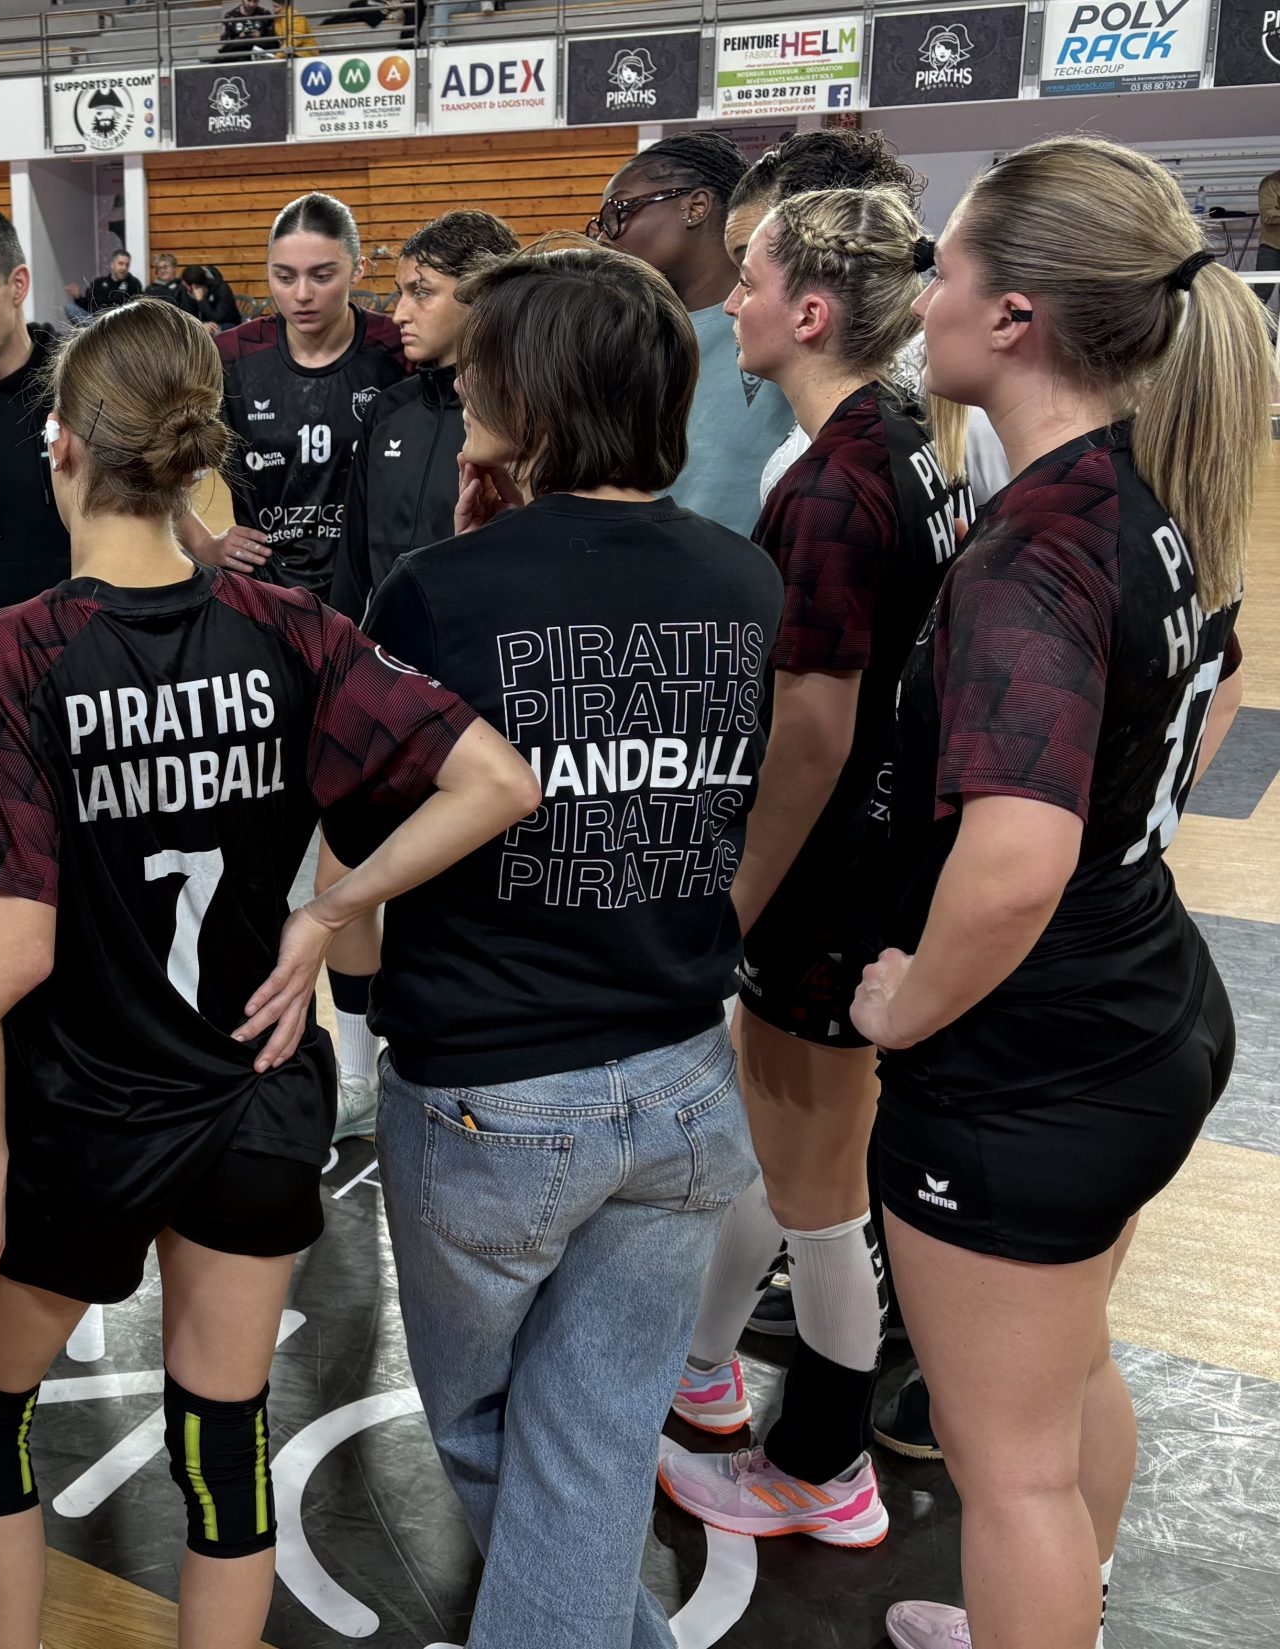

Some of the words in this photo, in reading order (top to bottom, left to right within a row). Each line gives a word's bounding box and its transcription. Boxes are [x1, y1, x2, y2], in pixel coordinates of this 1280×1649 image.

[1068, 0, 1190, 33] POLY
[724, 34, 779, 51] PEINTURE
[780, 27, 856, 58] HELM
[1056, 29, 1179, 65] RACK
[745, 49, 780, 60] FABRICE
[440, 58, 546, 98] ADEX
[915, 67, 973, 88] PIRATHS
[1054, 63, 1125, 77] TECH-GROUP
[54, 80, 107, 92] SUPPORTS
[110, 78, 123, 88] DE
[737, 89, 752, 100] 06
[755, 88, 770, 98] 30
[772, 87, 787, 97] 28
[789, 86, 801, 96] 77
[803, 85, 816, 95] 81
[1130, 83, 1141, 92] 03
[1142, 82, 1153, 91] 88
[1154, 82, 1164, 91] 80
[1165, 81, 1176, 90] 92
[1177, 80, 1188, 89] 27
[305, 97, 371, 111] ALEXANDRE
[374, 94, 406, 107] PETRI
[440, 100, 487, 112] TRANSPORT
[489, 100, 496, 110] &
[497, 97, 546, 109] LOGISTIQUE
[606, 89, 657, 108] PIRATHS
[208, 114, 251, 131] PIRATHS
[320, 123, 332, 133] 03
[334, 122, 346, 132] 88
[348, 121, 360, 130] 33
[363, 120, 374, 130] 18
[376, 119, 388, 129] 45
[248, 412, 275, 420] erima
[297, 424, 331, 463] 19
[496, 622, 763, 688] PIRATHS
[65, 669, 275, 755] PIRATHS
[503, 680, 759, 744] PIRATHS
[498, 839, 739, 909] PIRATHS
[144, 847, 224, 1014] 7
[918, 1189, 958, 1210] erima
